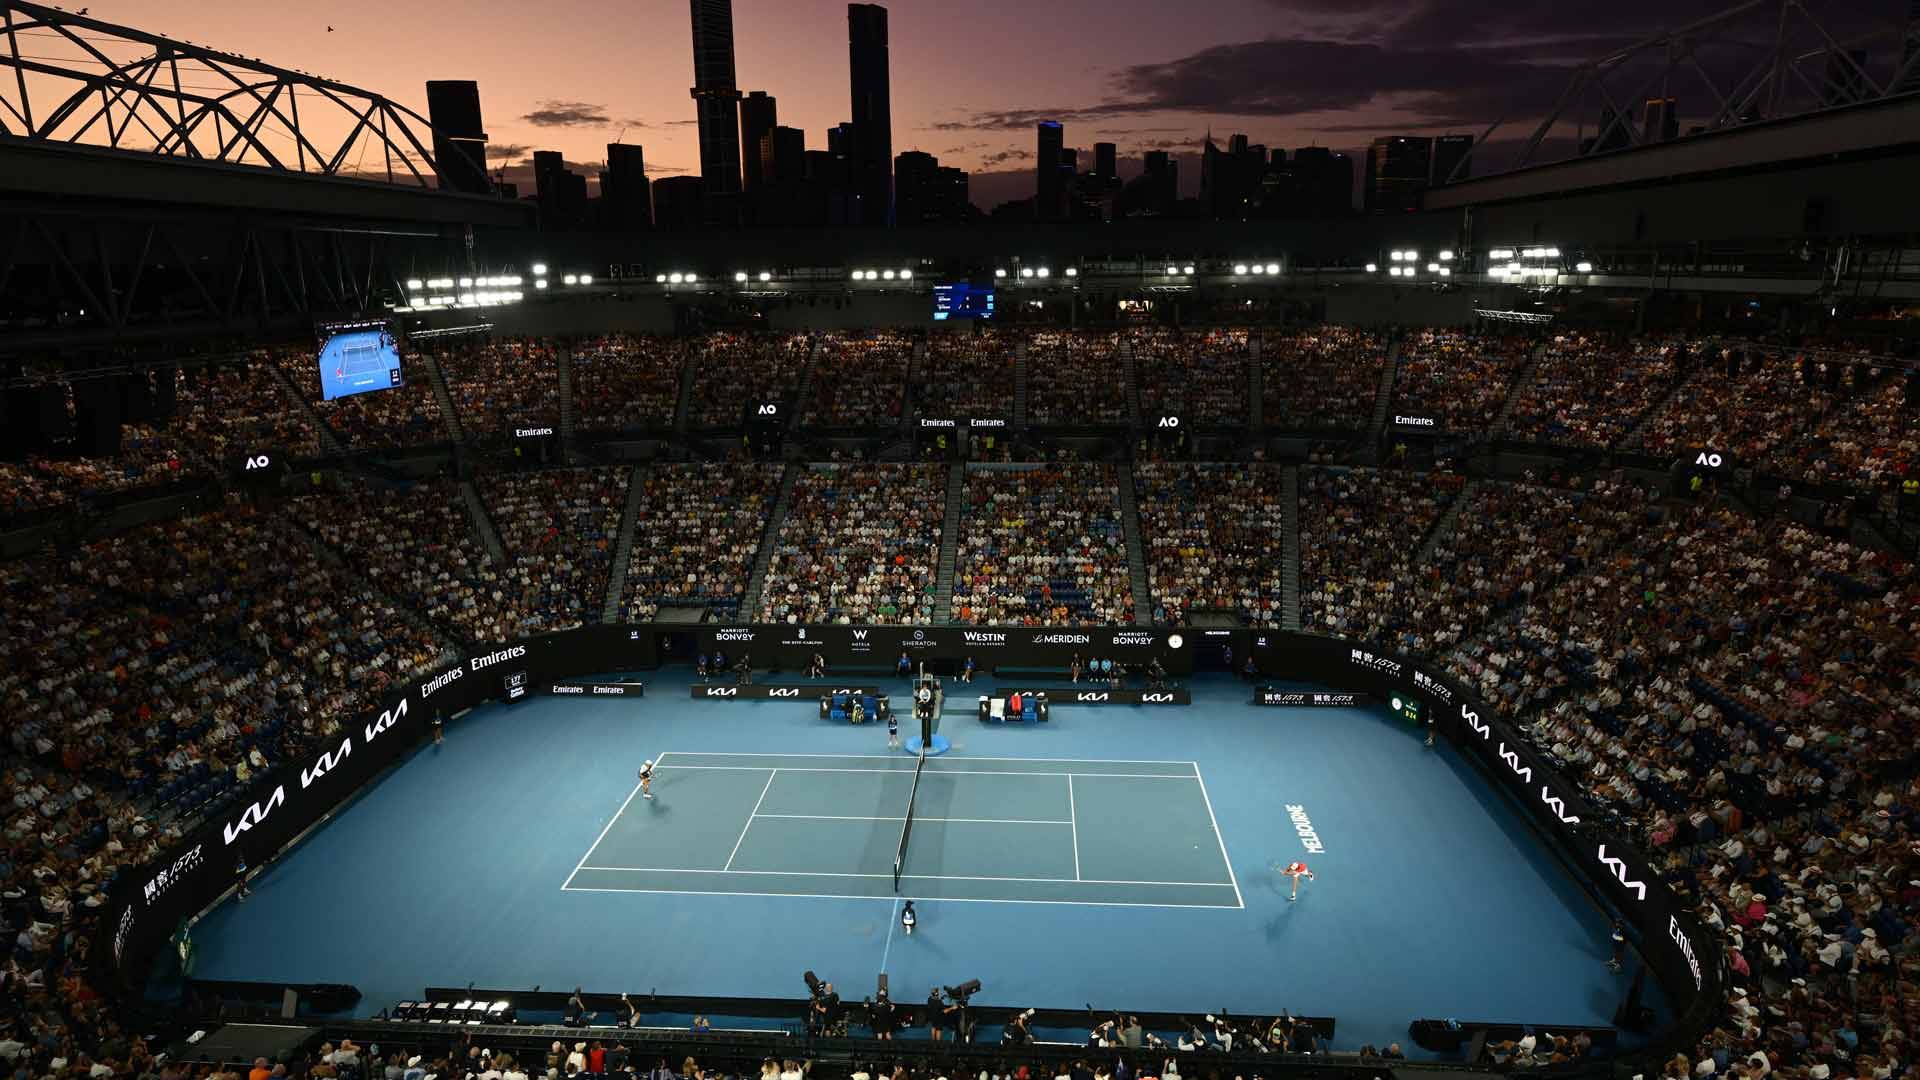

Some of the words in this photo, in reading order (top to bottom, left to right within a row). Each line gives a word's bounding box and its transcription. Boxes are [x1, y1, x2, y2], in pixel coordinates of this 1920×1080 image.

[757, 405, 777, 415] AO
[920, 418, 956, 428] Emirates
[970, 418, 1006, 428] Emirates
[1158, 416, 1179, 428] AO
[1394, 415, 1435, 427] Emirates
[515, 427, 553, 438] Emirates
[245, 455, 270, 470] AO
[1695, 452, 1722, 468] AO
[716, 633, 756, 641] BONVOY
[852, 629, 868, 640] W
[963, 631, 1005, 641] WESTIN
[1044, 634, 1090, 644] MERIDIEN
[1112, 636, 1154, 645] BONVOY
[470, 644, 526, 671] Emirates
[420, 666, 463, 699] Emirates
[552, 685, 584, 694] Emirates
[593, 685, 625, 694] Emirates
[1285, 804, 1325, 853] MELBOURNE
[1669, 914, 1701, 991] Emirates
